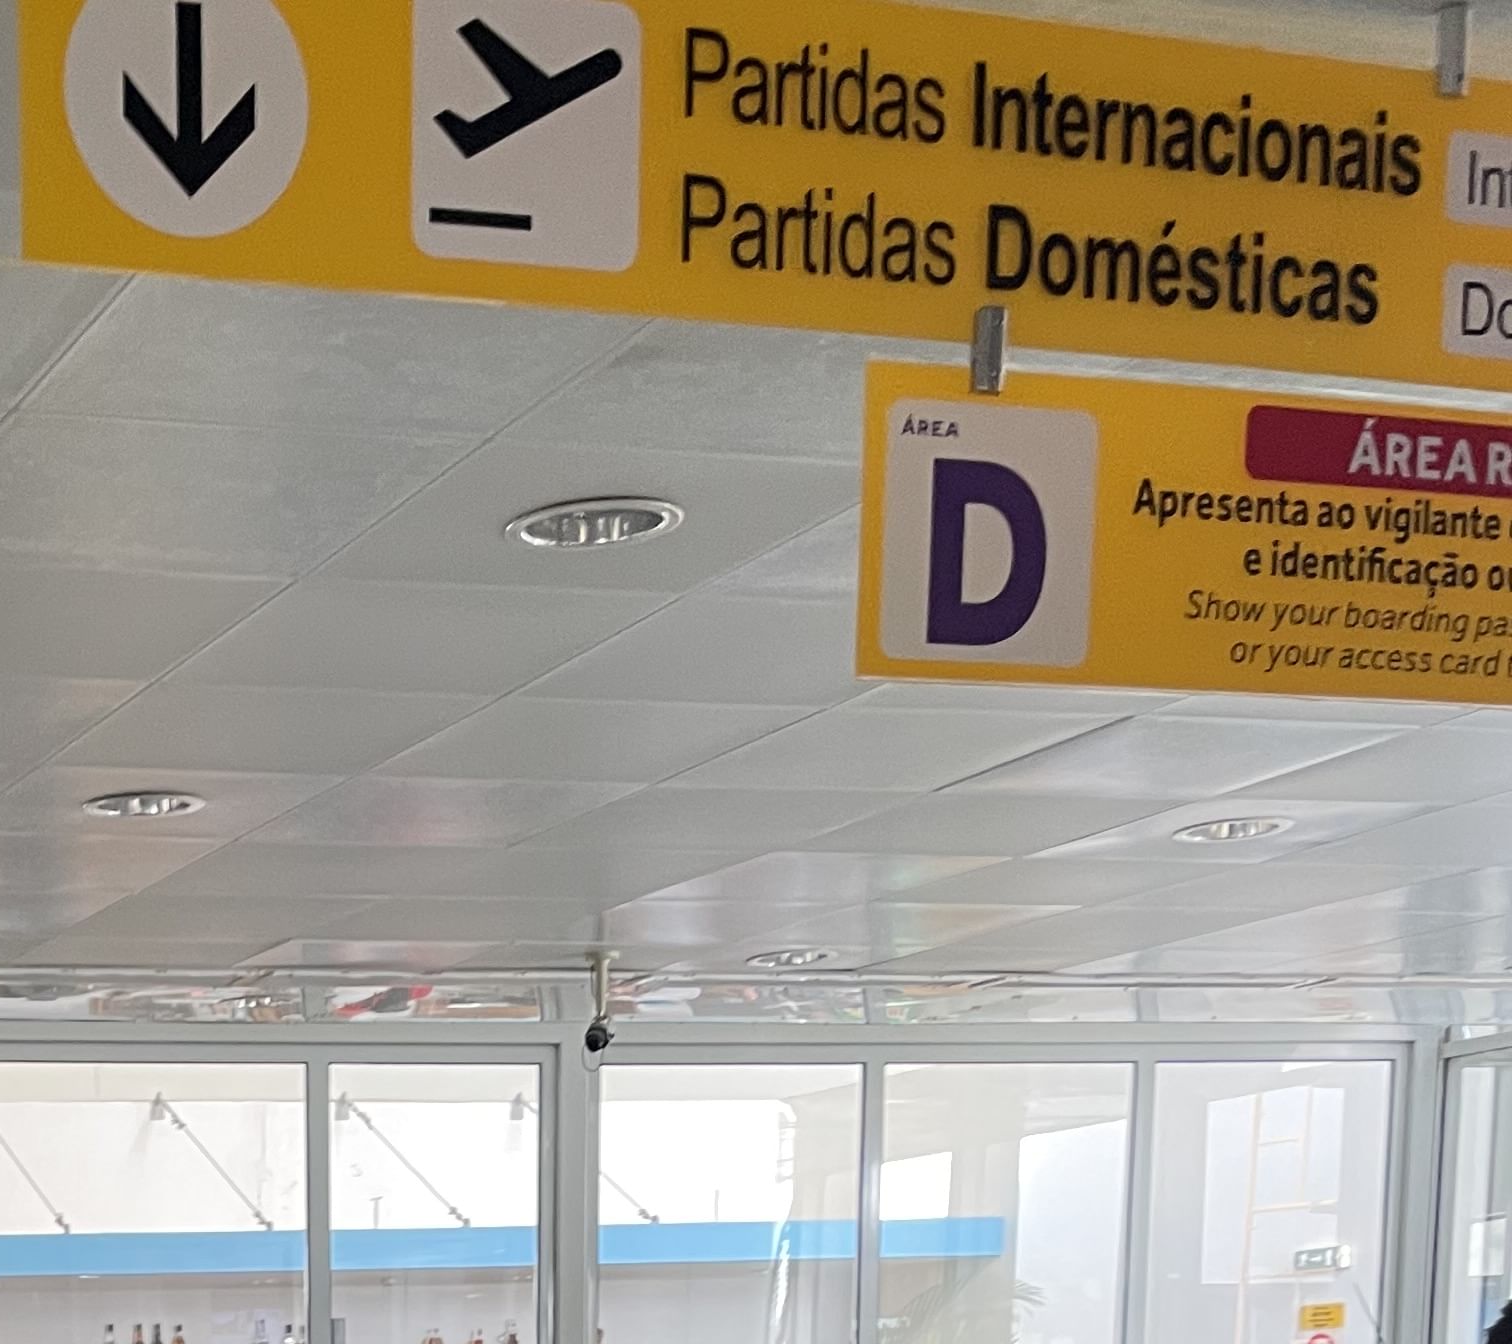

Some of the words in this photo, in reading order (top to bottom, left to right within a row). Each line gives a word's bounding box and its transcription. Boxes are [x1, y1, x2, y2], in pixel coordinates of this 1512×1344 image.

[683, 27, 946, 145] Partidas
[971, 60, 1423, 197] Internacionais
[1466, 149, 1512, 209] In
[680, 173, 957, 287] Partidas
[985, 204, 1380, 326] Domésticas
[900, 412, 960, 438] ÁREA
[1348, 418, 1477, 484] ÁREA
[1132, 477, 1309, 528] Apresenta
[1316, 500, 1356, 531] ao
[1363, 497, 1501, 545] vigilante
[925, 457, 1047, 646] D
[1242, 547, 1262, 577] e
[1270, 539, 1479, 599] identificação
[1184, 588, 1266, 624] Show
[1269, 601, 1339, 632] your
[1344, 600, 1470, 643] boarding
[1230, 640, 1259, 665] or
[1263, 642, 1338, 673] your
[1338, 646, 1432, 673] access
[1439, 649, 1501, 678] card
